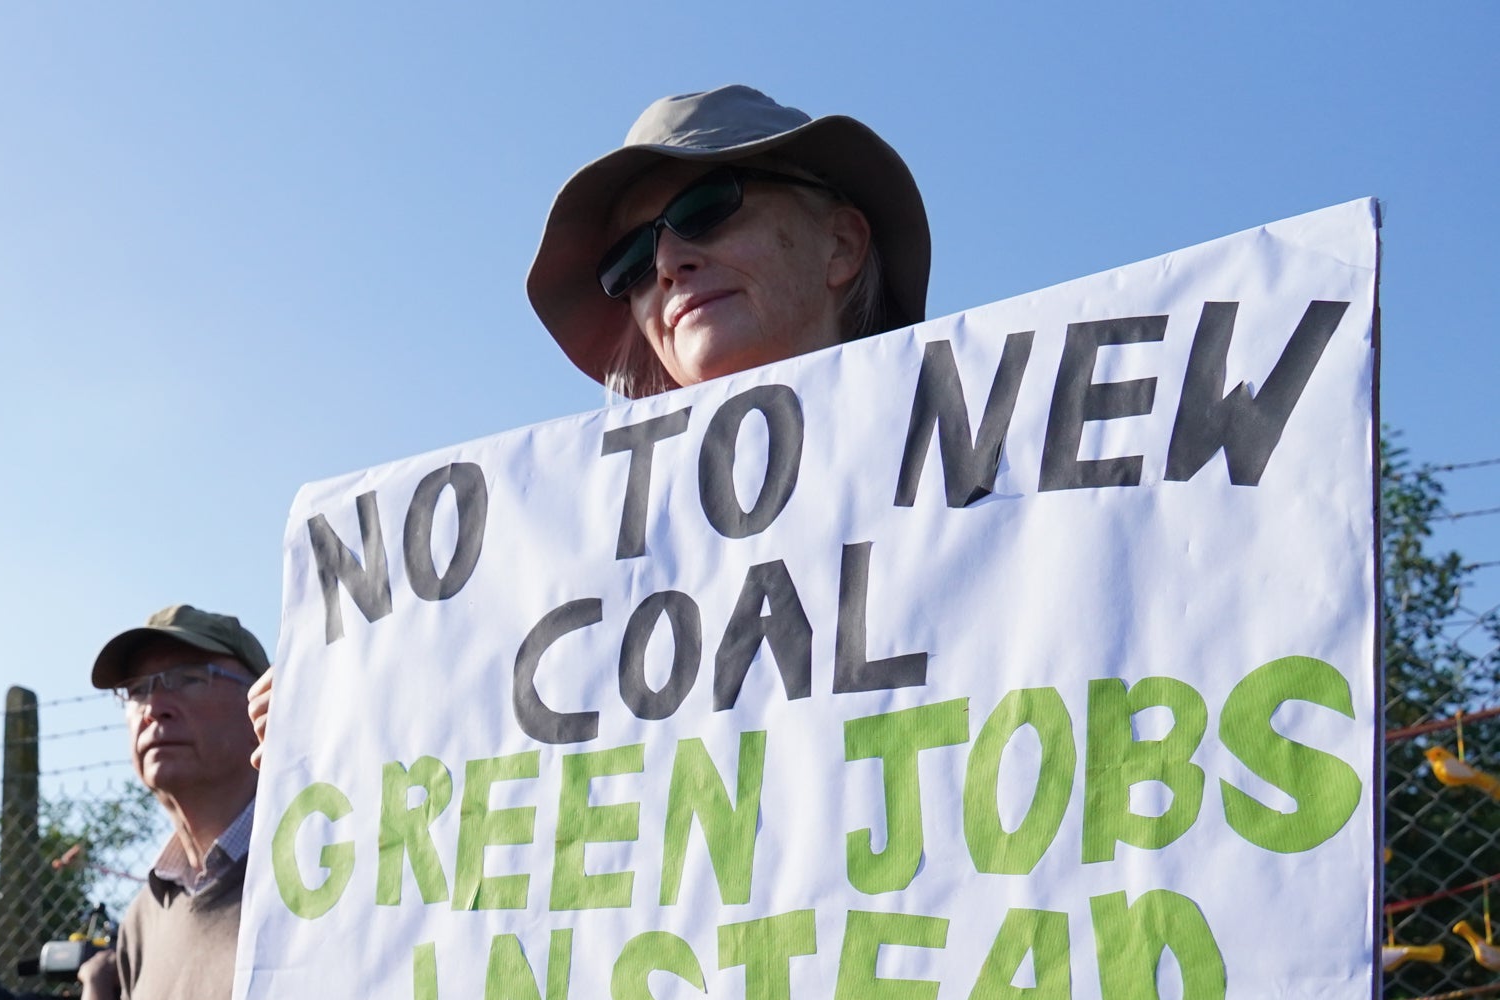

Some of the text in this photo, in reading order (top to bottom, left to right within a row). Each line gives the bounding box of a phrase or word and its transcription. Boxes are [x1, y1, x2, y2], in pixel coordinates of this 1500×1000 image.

[304, 300, 1350, 645] NO TO NEW
[512, 540, 929, 745] COAL
[271, 654, 1364, 921] GREEN JOBS
